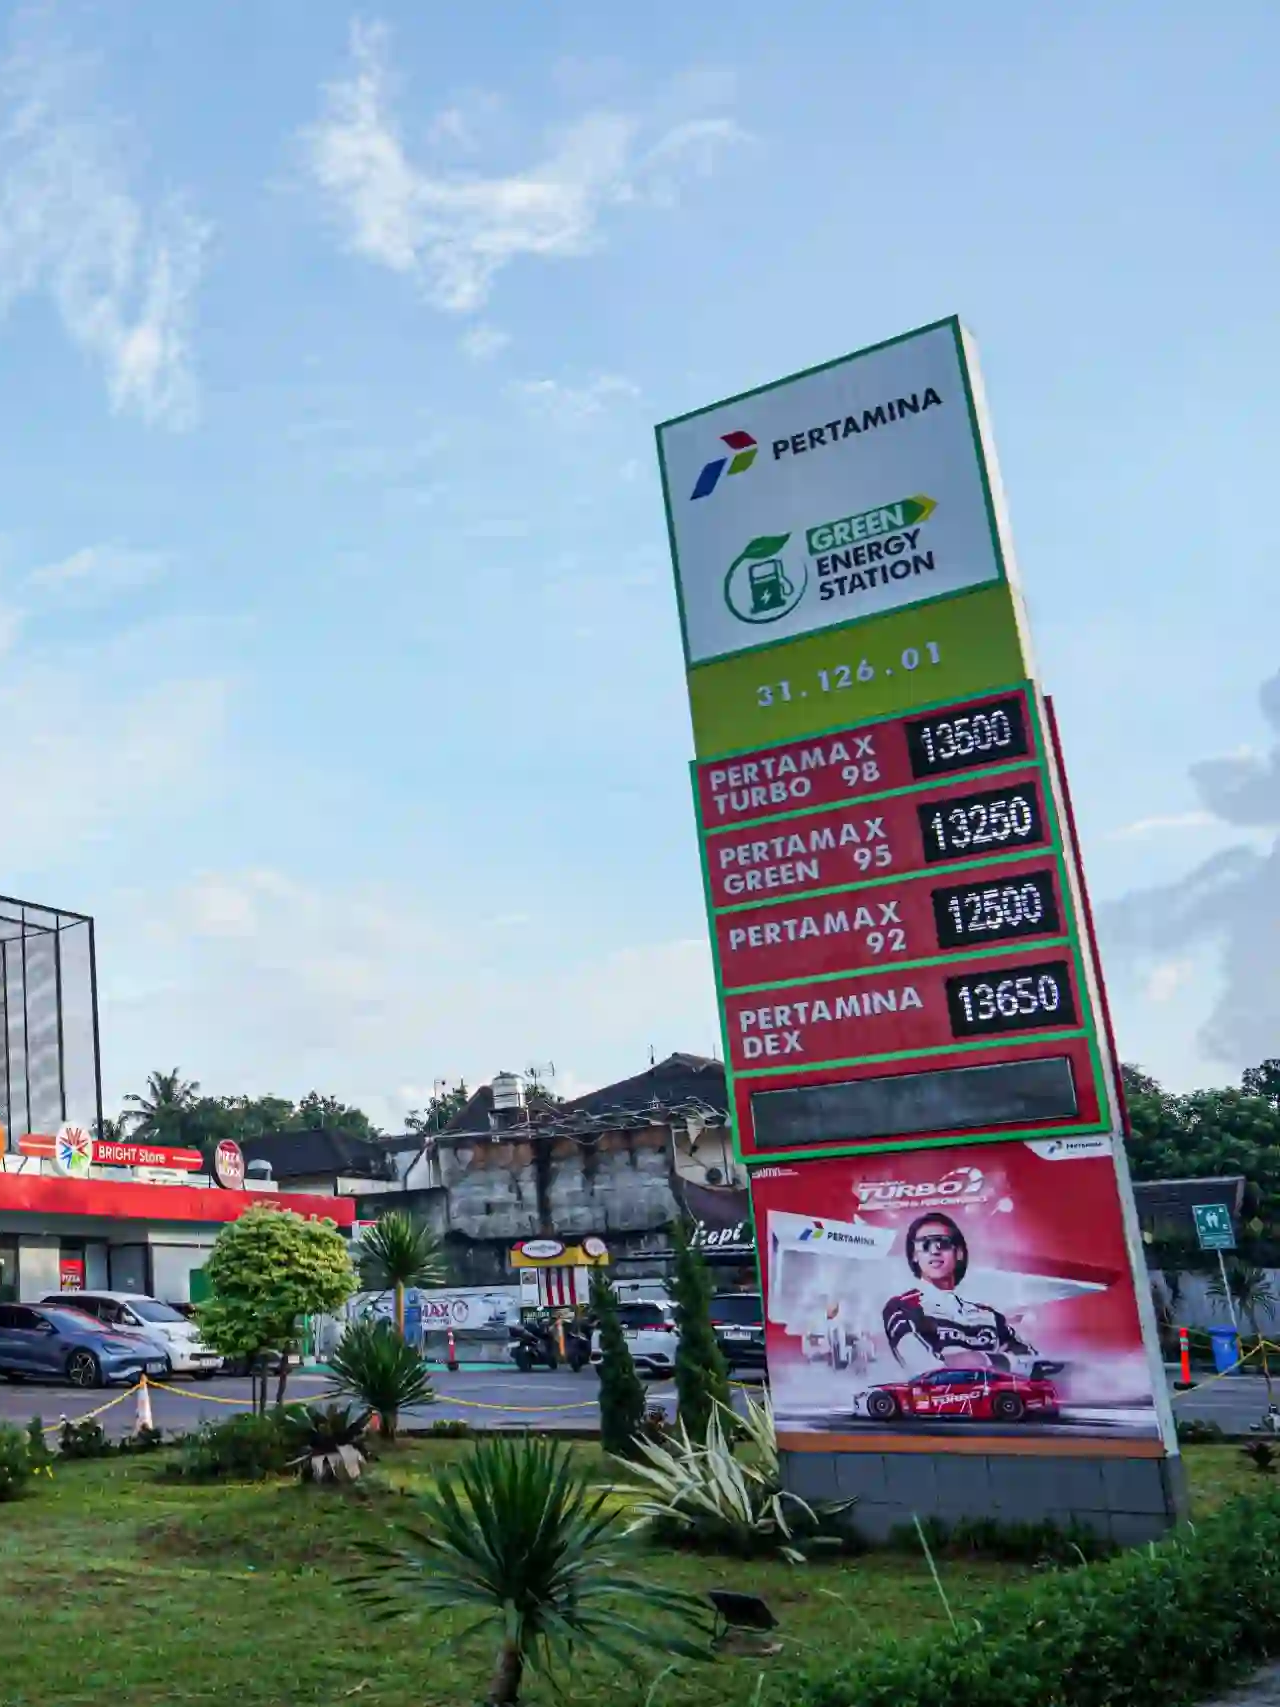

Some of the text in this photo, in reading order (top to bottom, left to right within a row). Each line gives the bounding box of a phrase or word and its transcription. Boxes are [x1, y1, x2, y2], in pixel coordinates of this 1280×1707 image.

[772, 387, 943, 460] PERTAMINA
[811, 504, 904, 550] GREEN
[816, 528, 921, 577] ENERGY
[820, 551, 935, 601] STATION
[922, 710, 1012, 763] 13500
[710, 735, 876, 791] PERTAMAX
[715, 761, 880, 815] TURBO 98
[719, 817, 888, 869] PERTAMAX
[931, 797, 1032, 850] 13250
[723, 845, 893, 895] GREEN 95
[729, 900, 902, 950] PERTAMAX
[947, 883, 1043, 933] 12500
[866, 928, 906, 954] 92
[739, 986, 924, 1033] PERTAMINA
[957, 975, 1059, 1023] 13650
[743, 1029, 804, 1059] DEX
[98, 1145, 166, 1164] BRIGHT Store
[857, 1180, 962, 1202] TURBO
[826, 1231, 876, 1247] PERTAMINA
